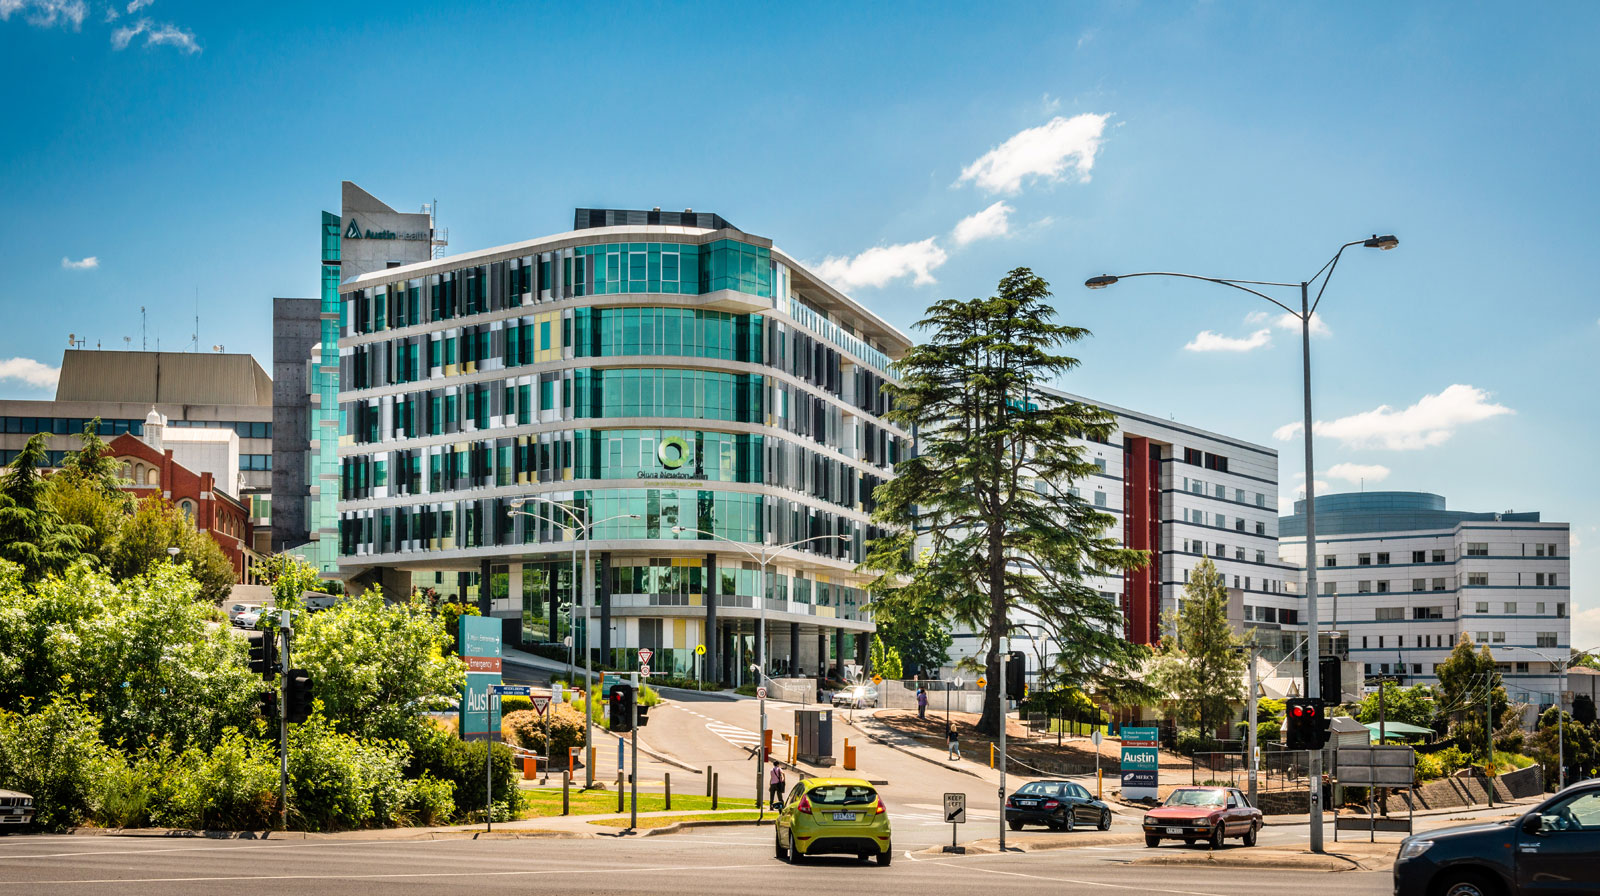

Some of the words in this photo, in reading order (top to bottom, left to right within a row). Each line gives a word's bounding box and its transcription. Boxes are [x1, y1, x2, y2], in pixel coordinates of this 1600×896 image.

[364, 229, 396, 240] Austin
[470, 658, 492, 670] Emergency
[1123, 752, 1155, 763] Austin
